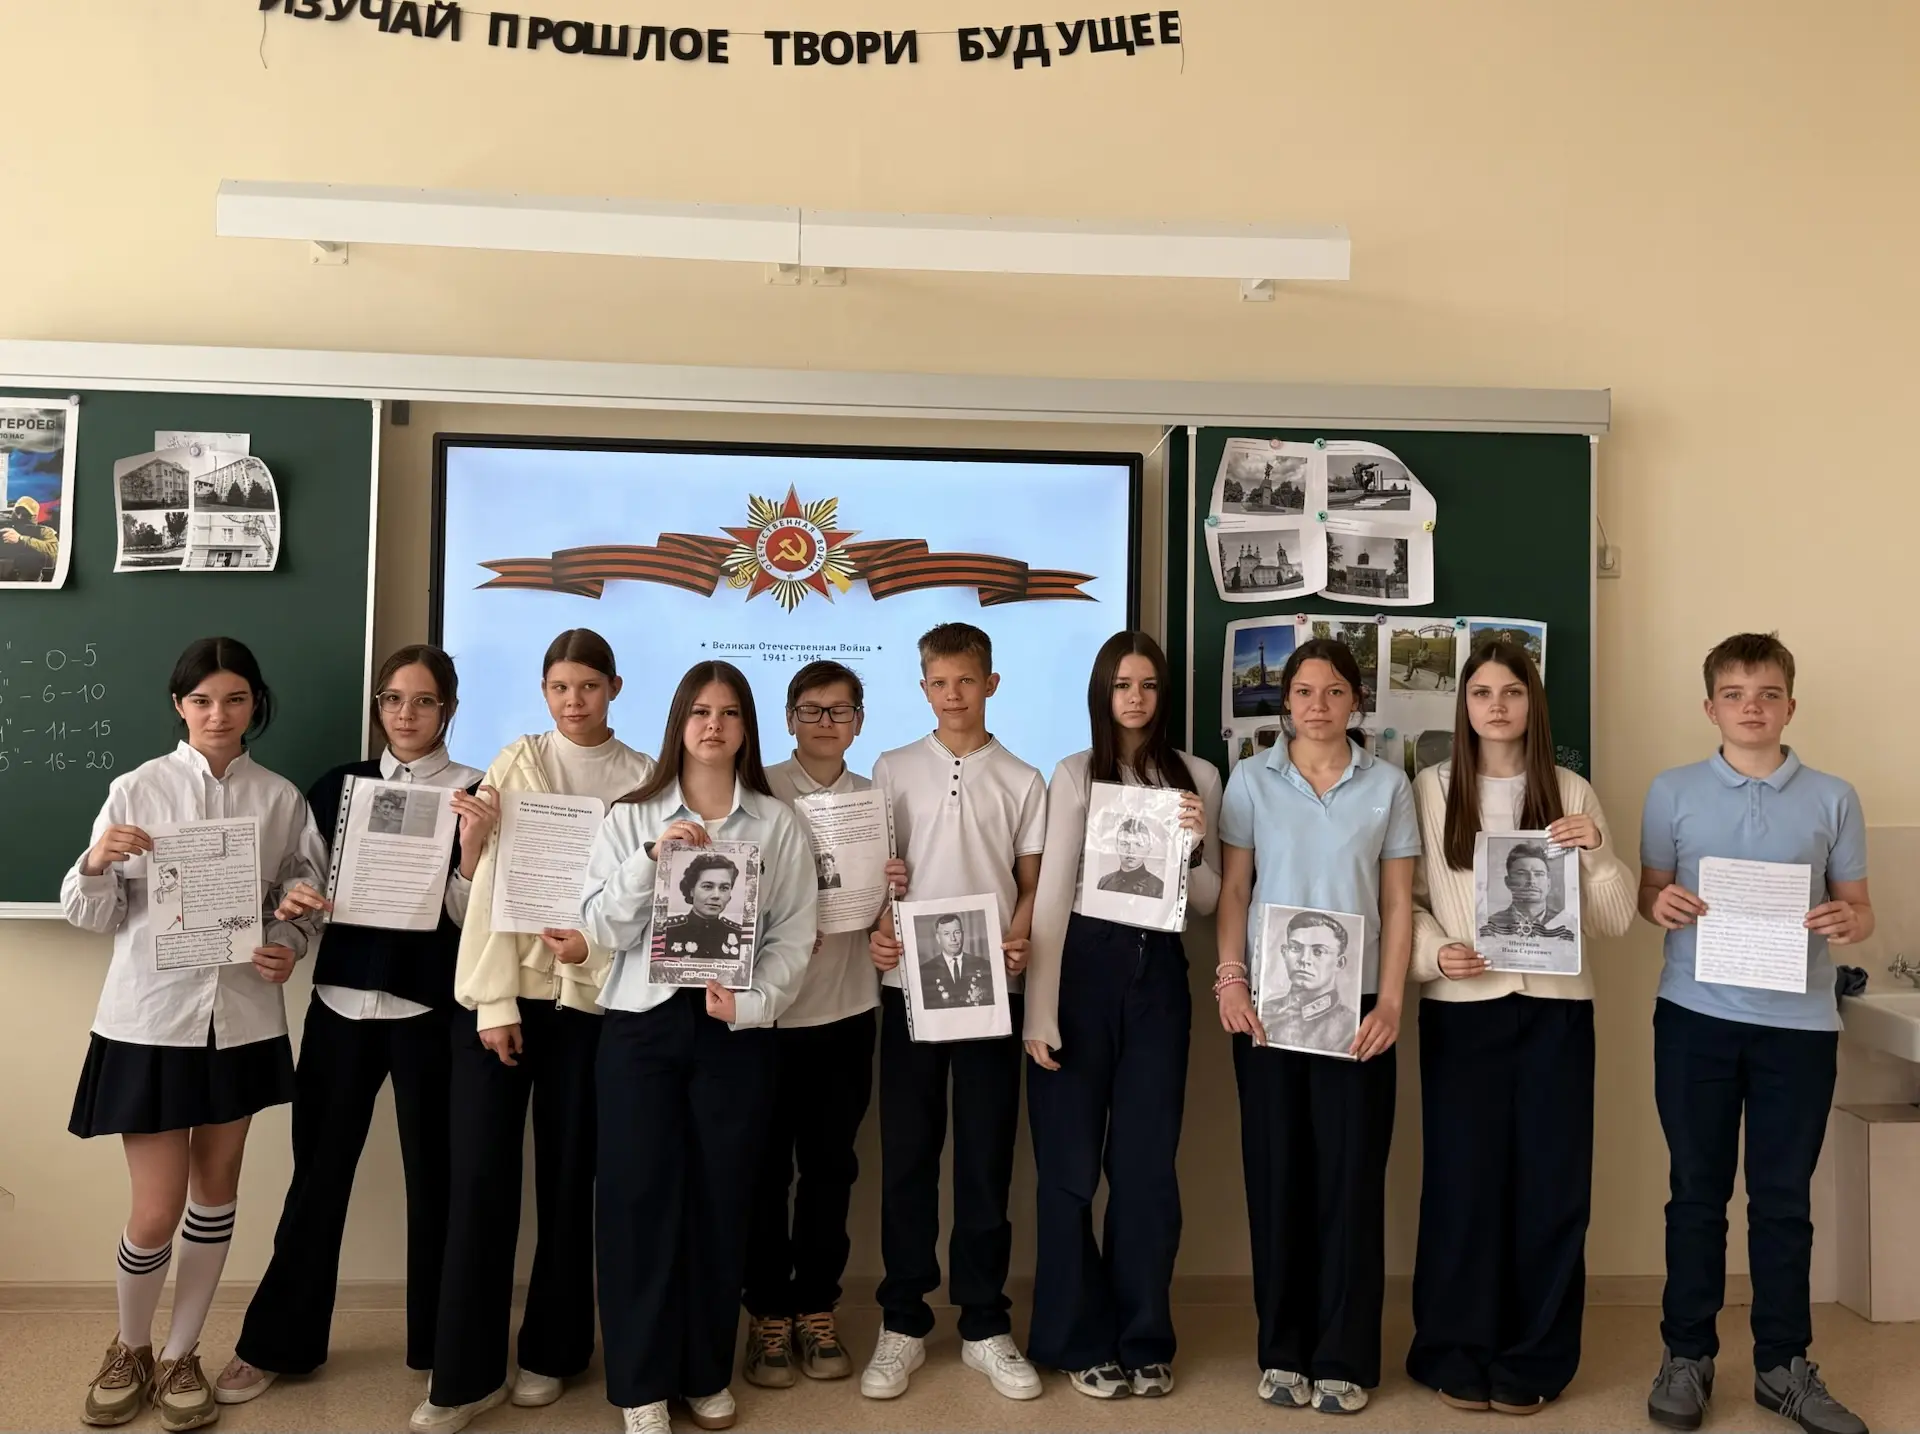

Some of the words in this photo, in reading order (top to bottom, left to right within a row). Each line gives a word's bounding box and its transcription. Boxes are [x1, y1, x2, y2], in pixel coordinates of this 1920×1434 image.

[488, 11, 729, 64] ПРОШЛОЕ
[764, 29, 918, 66] ТВОРИ
[958, 10, 1181, 70] БУДУЩЕЕ
[9, 432, 25, 440] НАС
[758, 519, 816, 571] ОТЕЧЕСТВЕННАЯ
[712, 641, 756, 650] Великая
[758, 641, 836, 651] Отечественная
[839, 643, 871, 652] Война
[762, 653, 786, 662] 1941
[797, 654, 822, 662] 1945
